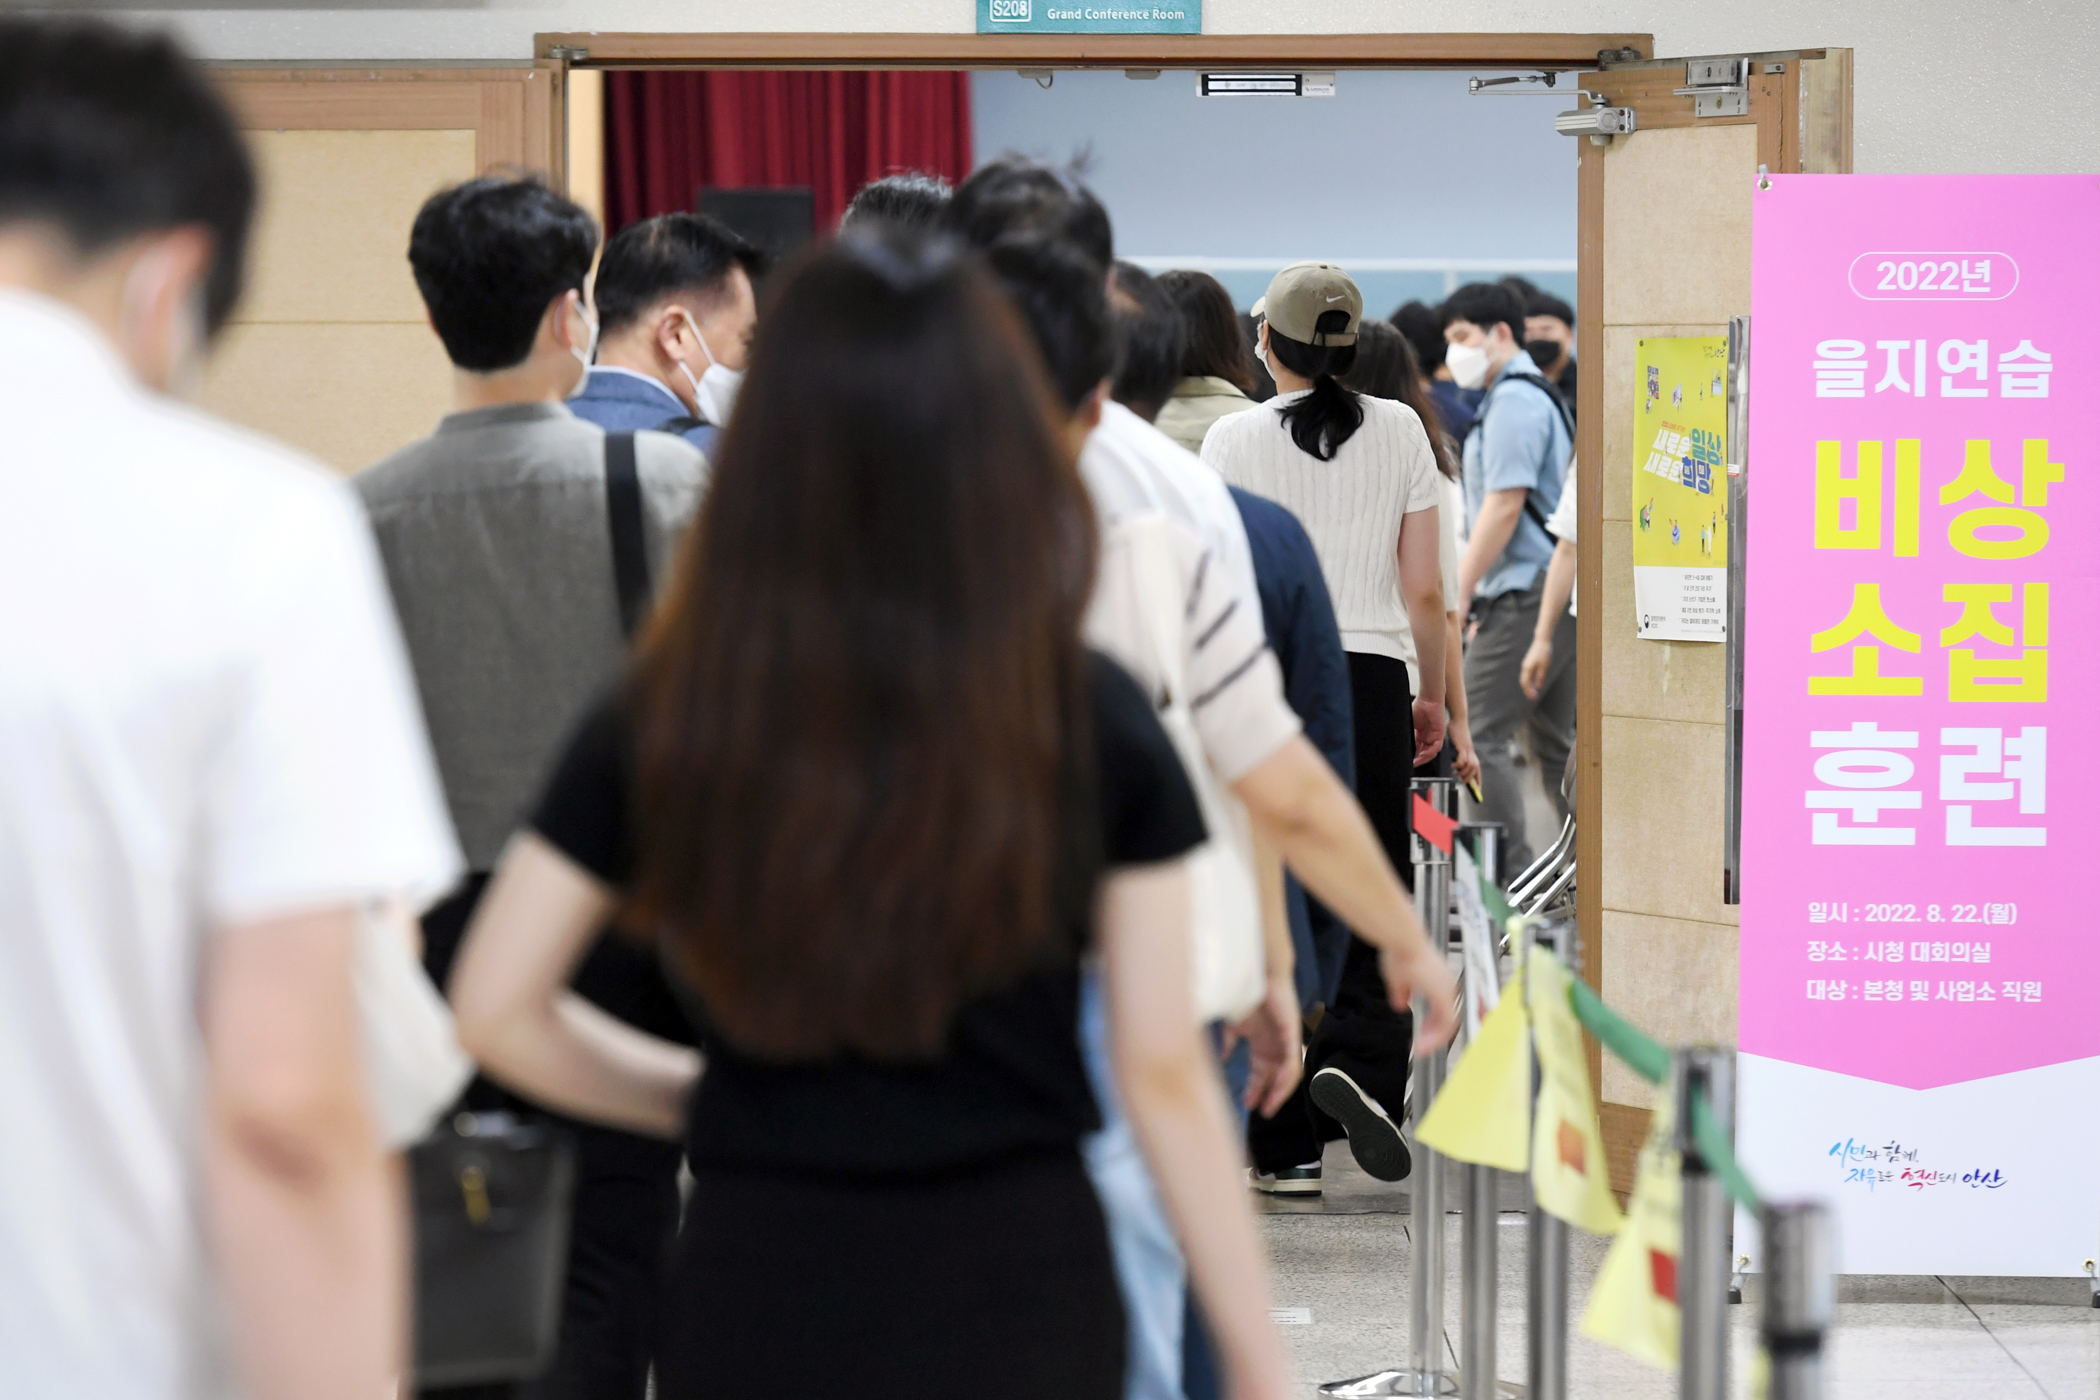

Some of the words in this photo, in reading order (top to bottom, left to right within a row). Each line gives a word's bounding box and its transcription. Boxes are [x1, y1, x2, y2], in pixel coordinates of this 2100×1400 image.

[993, 0, 1028, 17] S208
[1047, 8, 1082, 20] Grand
[1084, 8, 1150, 20] Conference
[1152, 8, 1185, 20] Room
[1876, 259, 1991, 293] 2022년
[1812, 338, 2054, 398] 을지연습
[1652, 428, 1693, 458] 새로운
[1691, 428, 1722, 466] 일상
[1643, 451, 1685, 482] 새로운
[1682, 455, 1712, 495] 희망
[1815, 438, 2065, 560] 비상
[1808, 582, 2049, 703] 소집
[1805, 721, 2048, 847] 훈련
[1807, 901, 1848, 924] 일시
[1864, 903, 1922, 923] 2022.
[1926, 903, 1946, 923] 8.
[1951, 902, 2018, 926] 22.(월)
[1806, 940, 1848, 962] 장소
[1863, 941, 1905, 963] 시청
[1910, 941, 1991, 964] 대회의실
[1806, 979, 1848, 1001] 대상
[1863, 979, 1904, 1002] 본청
[1909, 980, 1930, 1002] 및
[1934, 980, 1996, 1002] 사업소
[2001, 981, 2042, 1003] 직원
[1828, 1137, 1881, 1169] 시민과
[1900, 1167, 1957, 1192] 혁신도시
[1962, 1168, 2008, 1189] 안산
